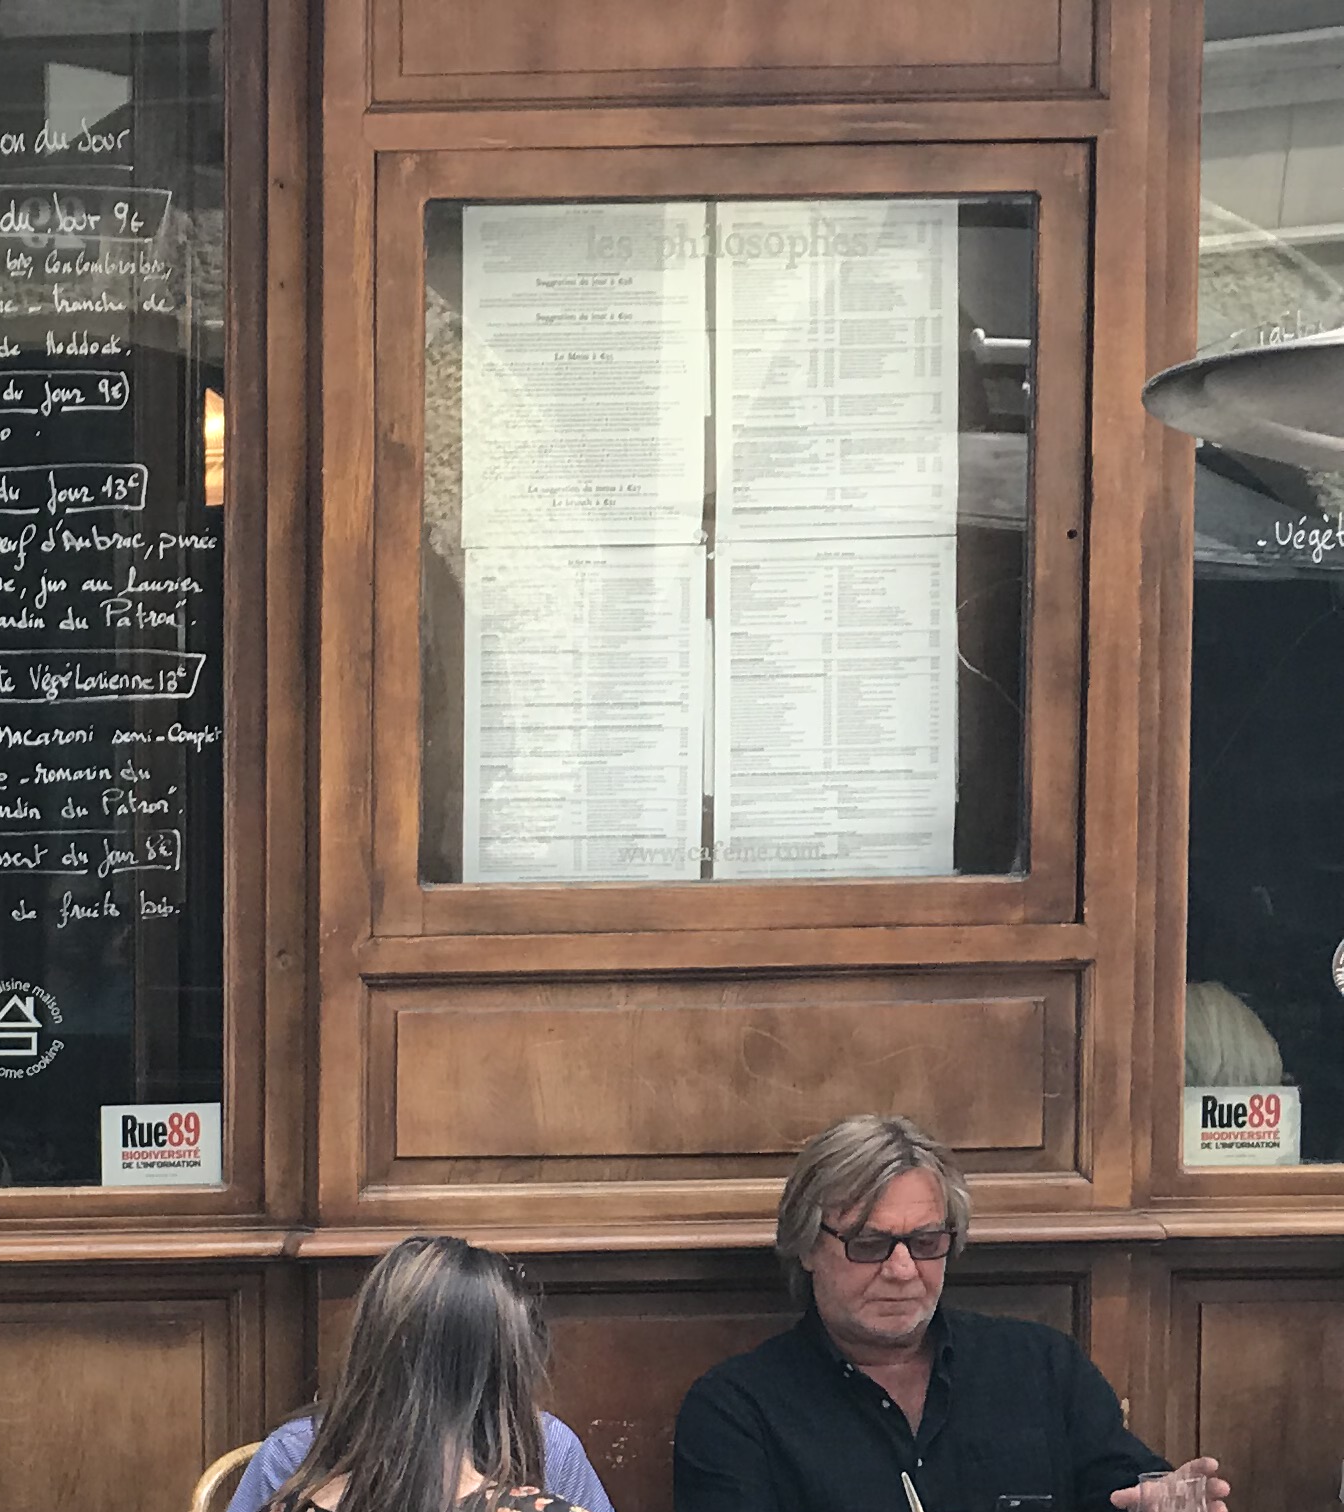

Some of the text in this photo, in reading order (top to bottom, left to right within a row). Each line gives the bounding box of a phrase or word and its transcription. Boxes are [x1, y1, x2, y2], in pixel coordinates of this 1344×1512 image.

[34, 118, 70, 155] du
[0, 201, 35, 232] du
[58, 606, 90, 631] du
[120, 759, 151, 783] du
[61, 797, 89, 819] du
[61, 844, 89, 868] du
[11, 898, 38, 922] de
[32, 985, 63, 1024] maison
[26, 1039, 65, 1076] cooking
[1201, 1094, 1281, 1129] Rue89
[121, 1111, 201, 1148] Rue89
[1201, 1130, 1280, 1141] BIODIVERSITÉ
[122, 1147, 200, 1160] BIODIVERSITÉ
[1201, 1141, 1280, 1150] DE L'INFORMATION
[122, 1160, 201, 1169] DE L'INFORMATION
